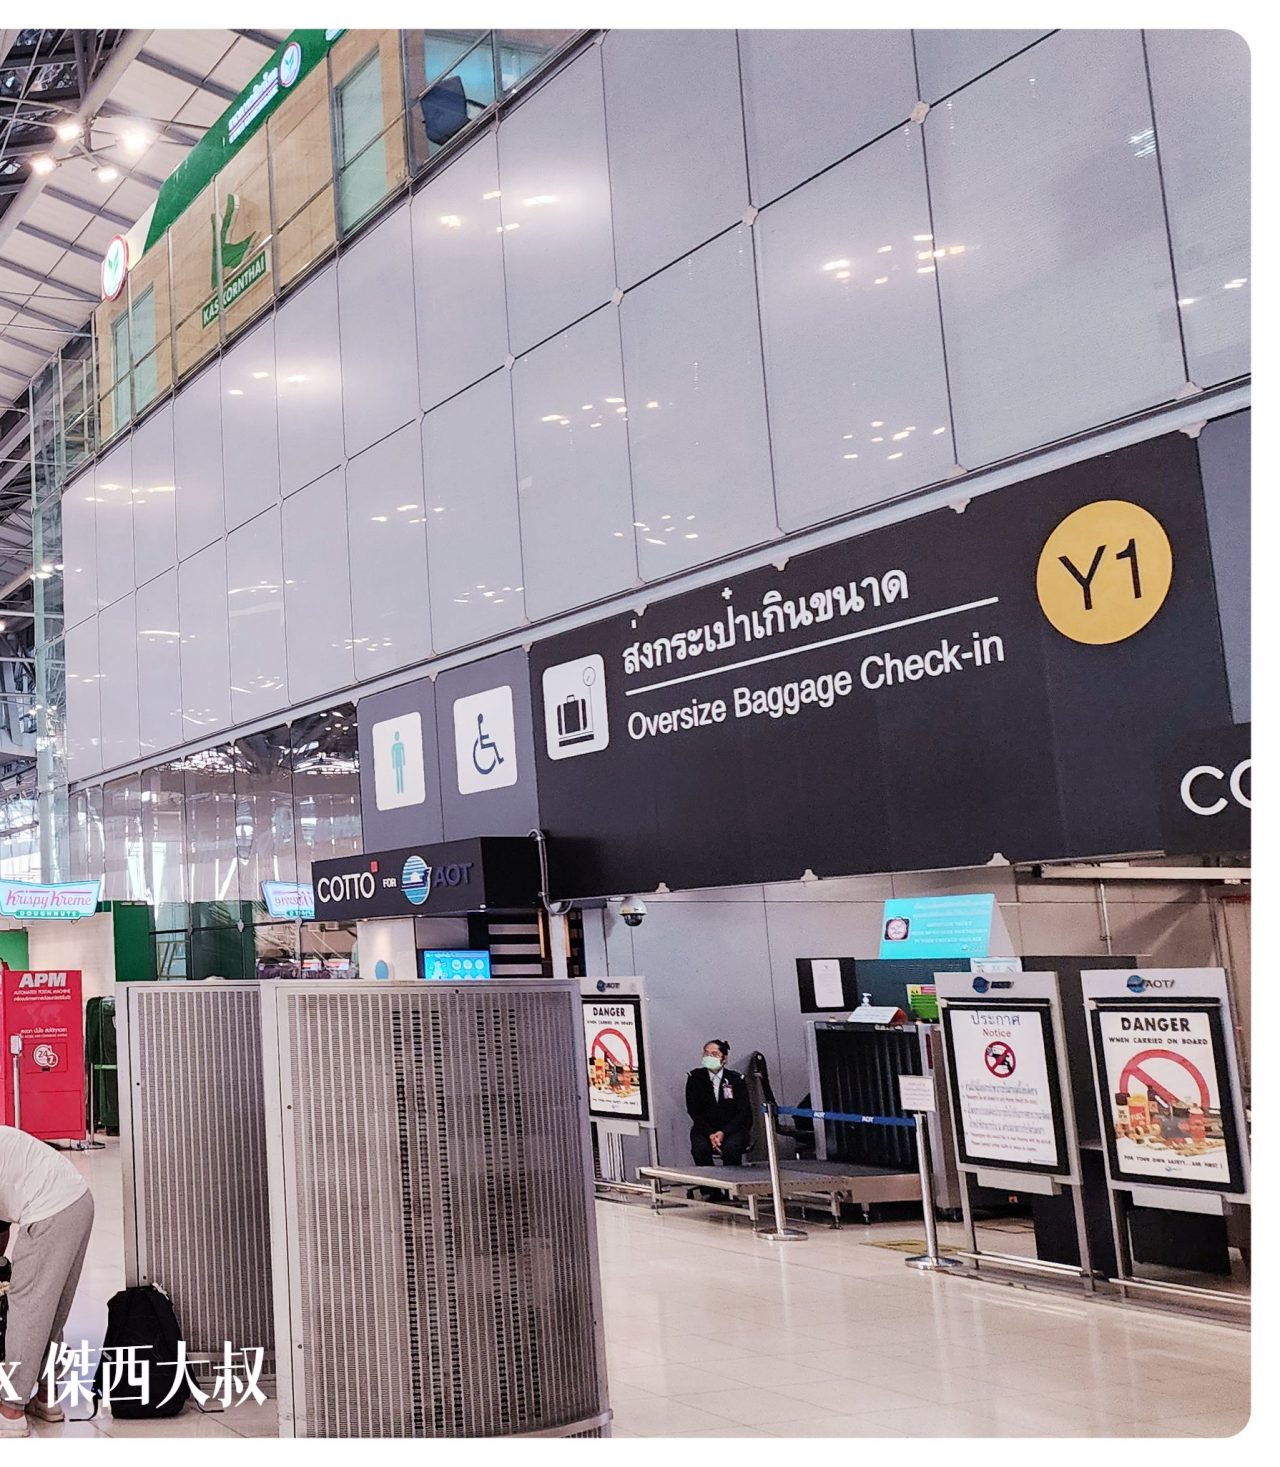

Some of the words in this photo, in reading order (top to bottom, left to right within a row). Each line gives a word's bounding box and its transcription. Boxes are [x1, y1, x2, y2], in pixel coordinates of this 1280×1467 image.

[203, 255, 265, 325] KASKORNTHAI
[1058, 538, 1142, 611] Y1
[622, 569, 910, 675] ส่งกระเป๋าเกินขนาด
[628, 698, 727, 740] Oversize
[733, 669, 853, 718] Baggage
[860, 631, 1005, 690] Check-in
[317, 871, 376, 903] COTTO
[382, 878, 397, 888] FOR
[434, 862, 473, 888] AOT
[6, 889, 50, 908] Krispy
[50, 889, 93, 906] Kreme
[18, 972, 67, 988] APM
[593, 1007, 626, 1017] DANGER
[970, 1010, 1021, 1026] ประกาศ
[983, 1028, 1012, 1038] Notice
[1120, 1017, 1191, 1032] DANGER
[37, 1050, 48, 1058] 24
